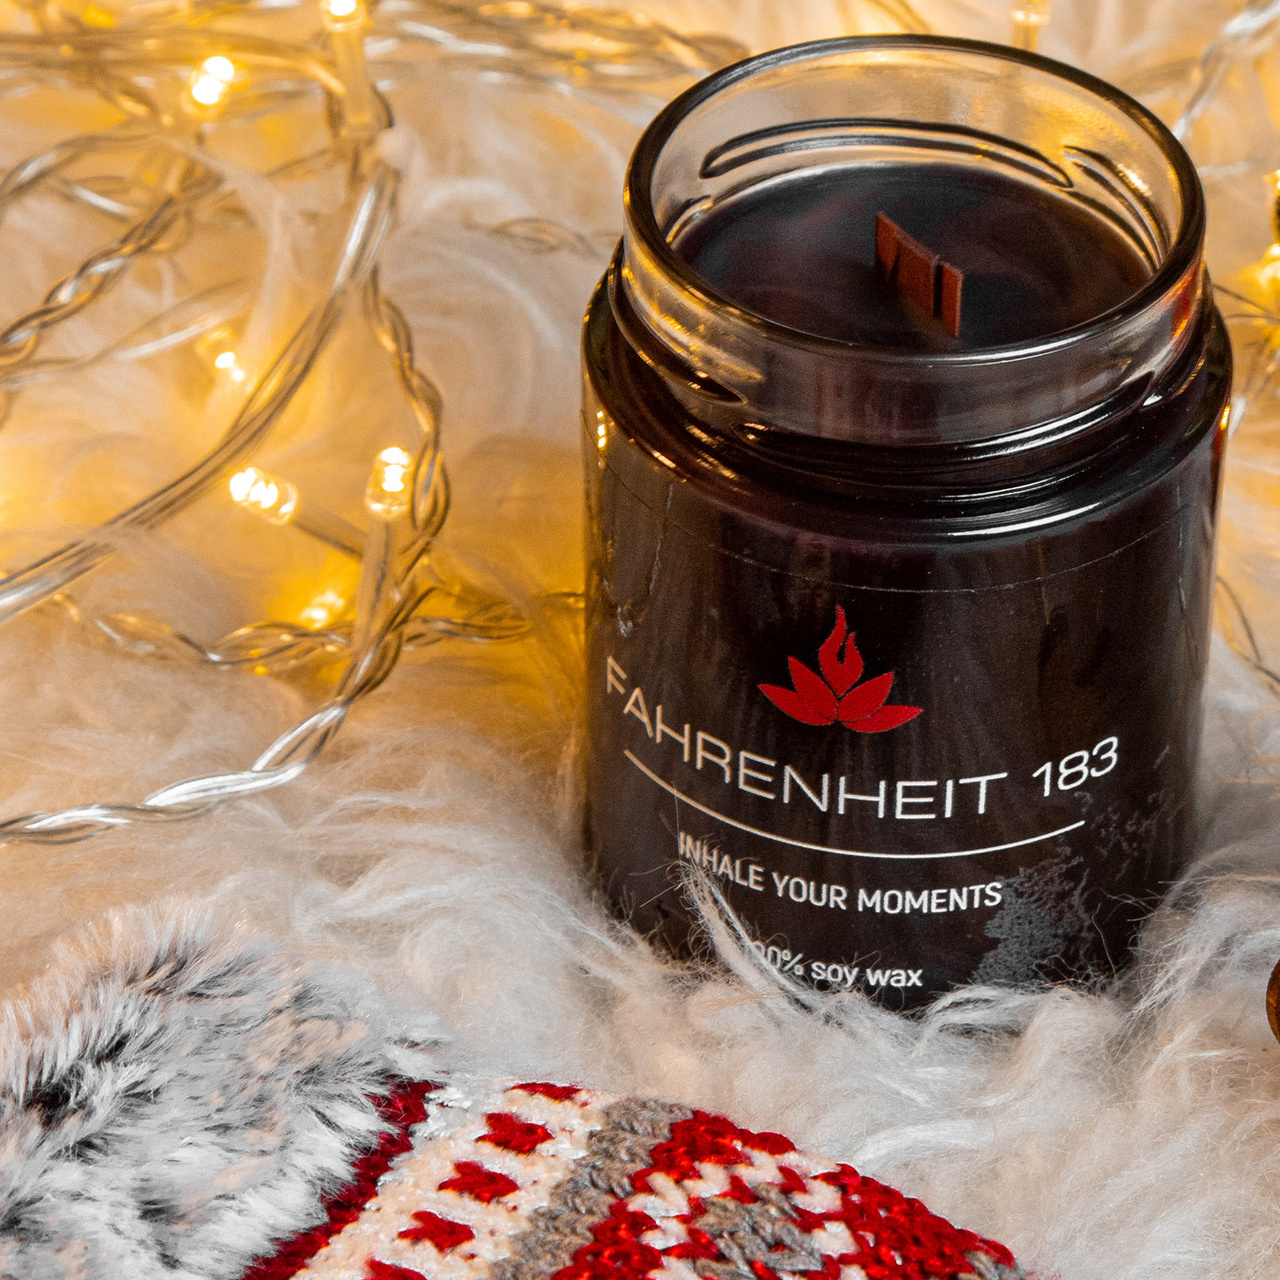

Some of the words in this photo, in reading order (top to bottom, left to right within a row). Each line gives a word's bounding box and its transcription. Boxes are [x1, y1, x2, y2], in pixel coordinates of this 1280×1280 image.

[605, 656, 1008, 820] FAHRENHEIT
[1033, 736, 1120, 798] 183
[678, 830, 765, 892] INHALE
[772, 871, 848, 911] YOUR
[857, 882, 1003, 915] MOMENTS
[810, 959, 858, 989] soy
[866, 965, 923, 987] wax
